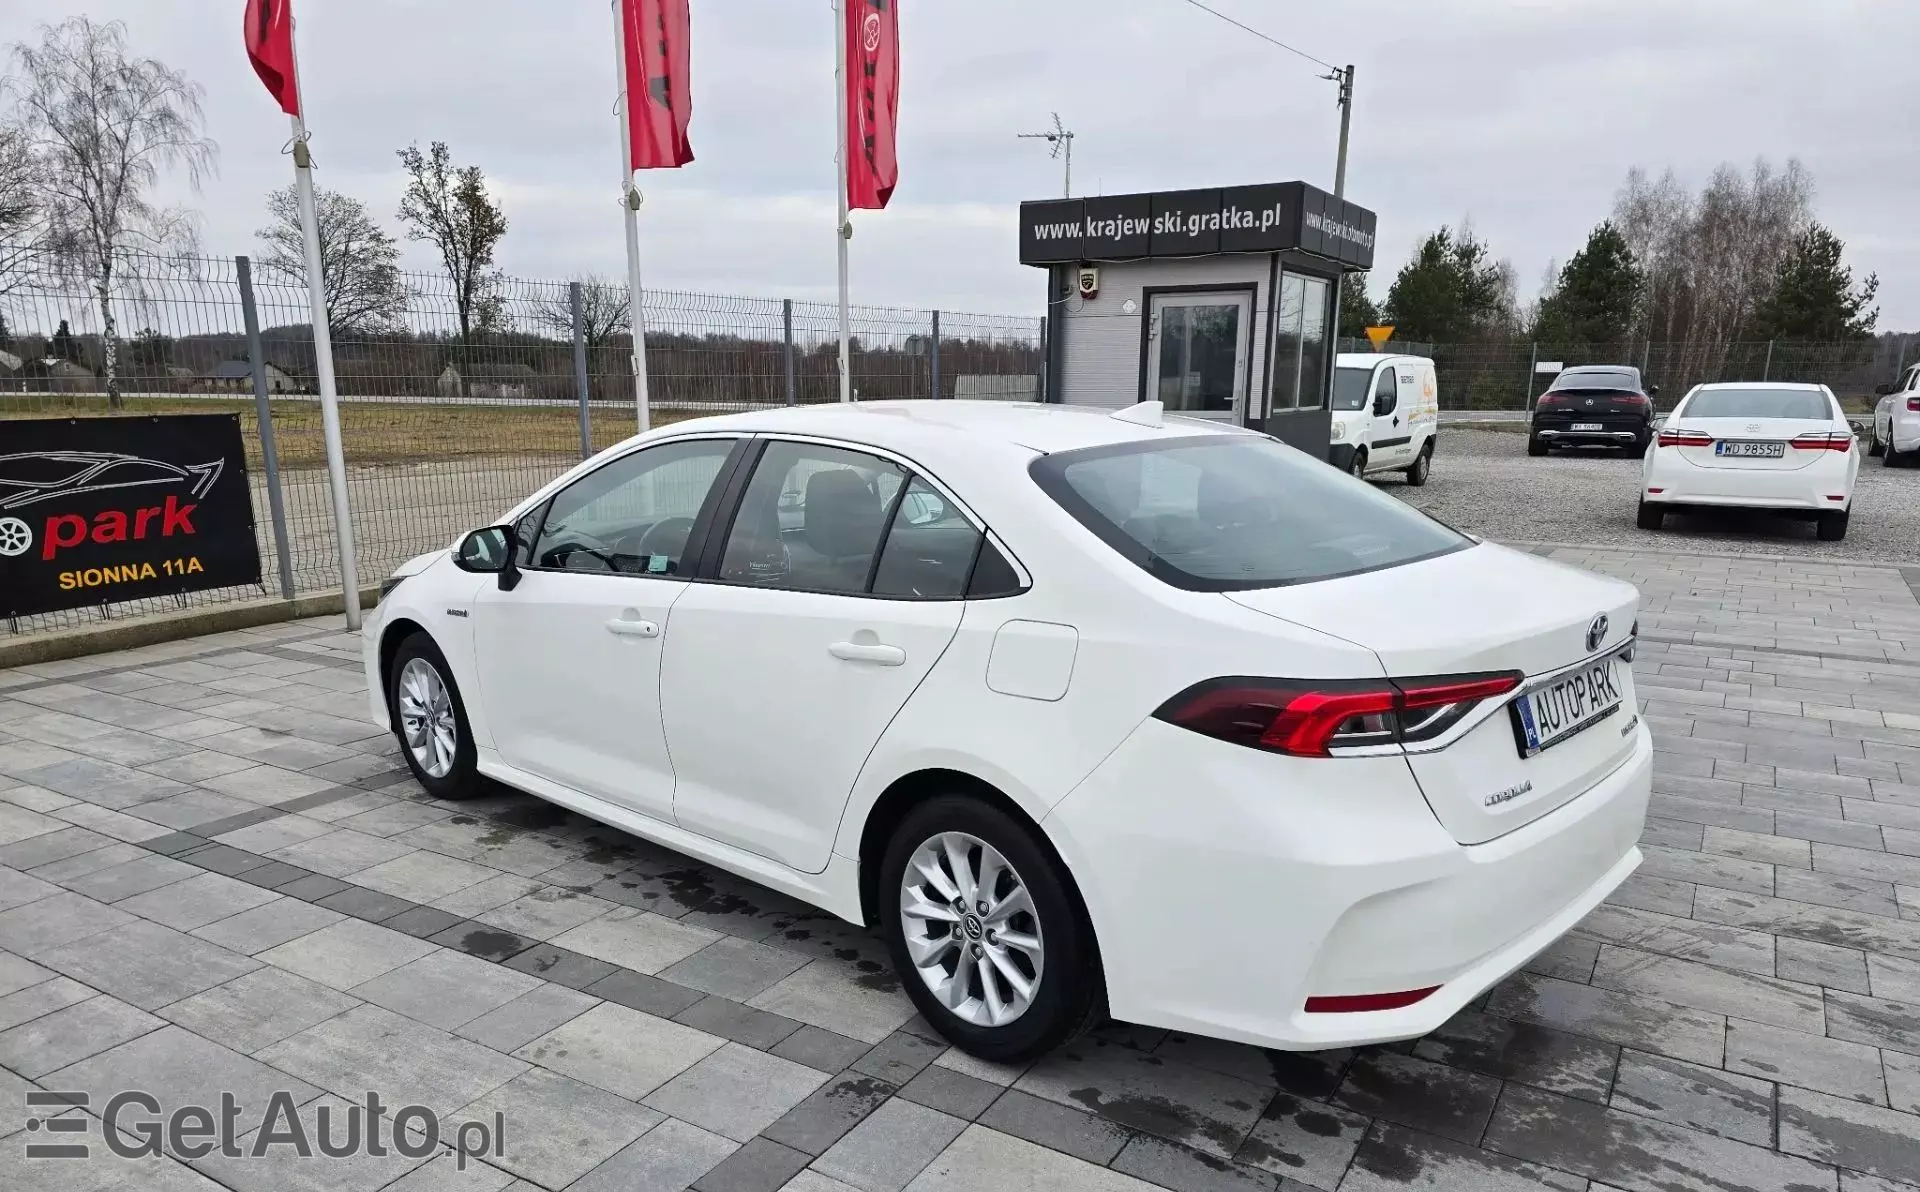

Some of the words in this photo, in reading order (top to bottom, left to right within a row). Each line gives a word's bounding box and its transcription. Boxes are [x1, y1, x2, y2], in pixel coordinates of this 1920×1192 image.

[1034, 203, 1281, 241] www.krajewski.gratka.pl
[1725, 444, 1740, 454] WD
[1744, 444, 1782, 455] 9855H
[42, 496, 198, 560] park
[59, 564, 157, 590] SIONNA
[162, 556, 204, 576] 11A
